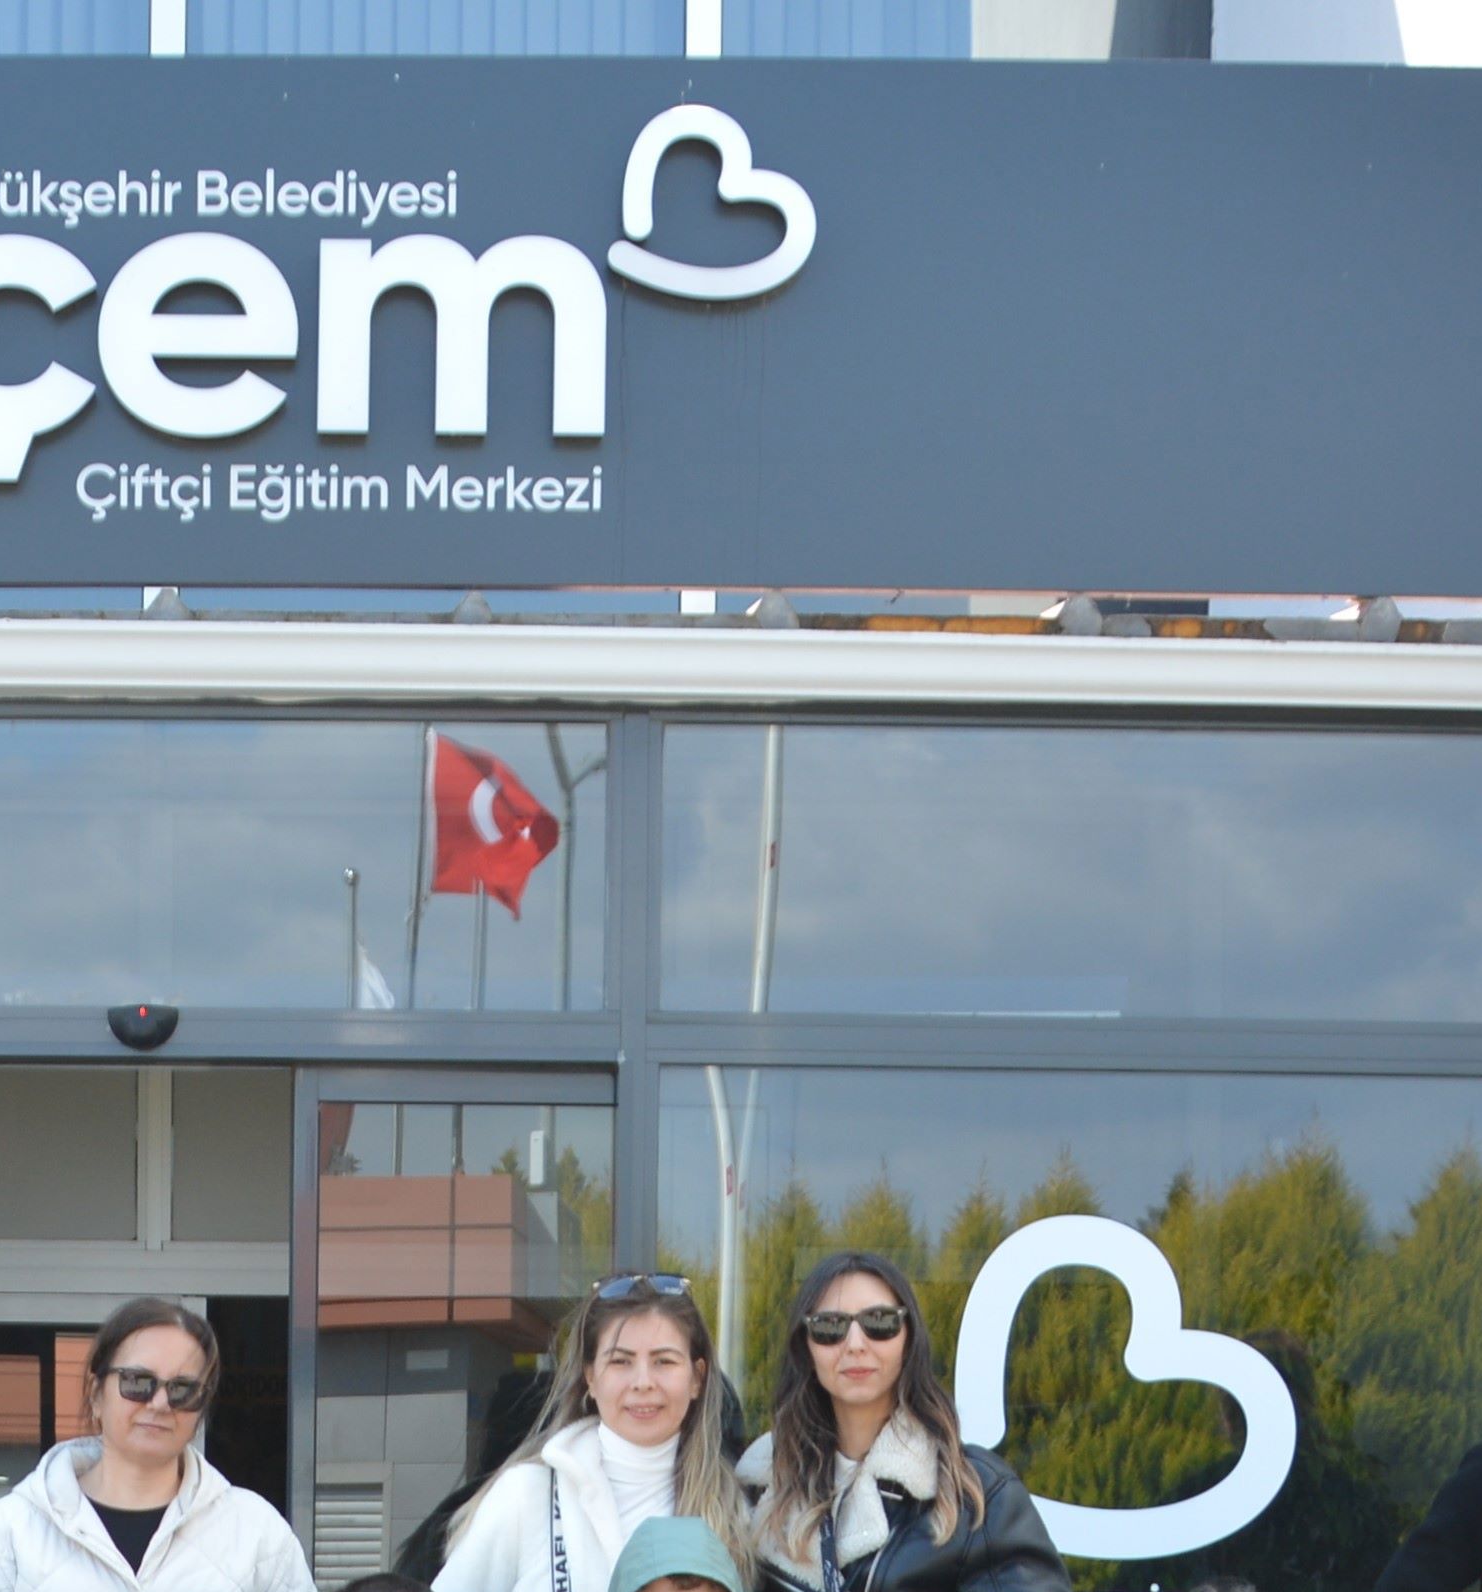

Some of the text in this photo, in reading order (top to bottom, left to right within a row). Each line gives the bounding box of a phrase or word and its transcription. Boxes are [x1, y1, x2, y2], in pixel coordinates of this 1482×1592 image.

[196, 167, 458, 228] Belediyesi
[75, 463, 604, 523] Çiftçi Eğitim Merkezi
